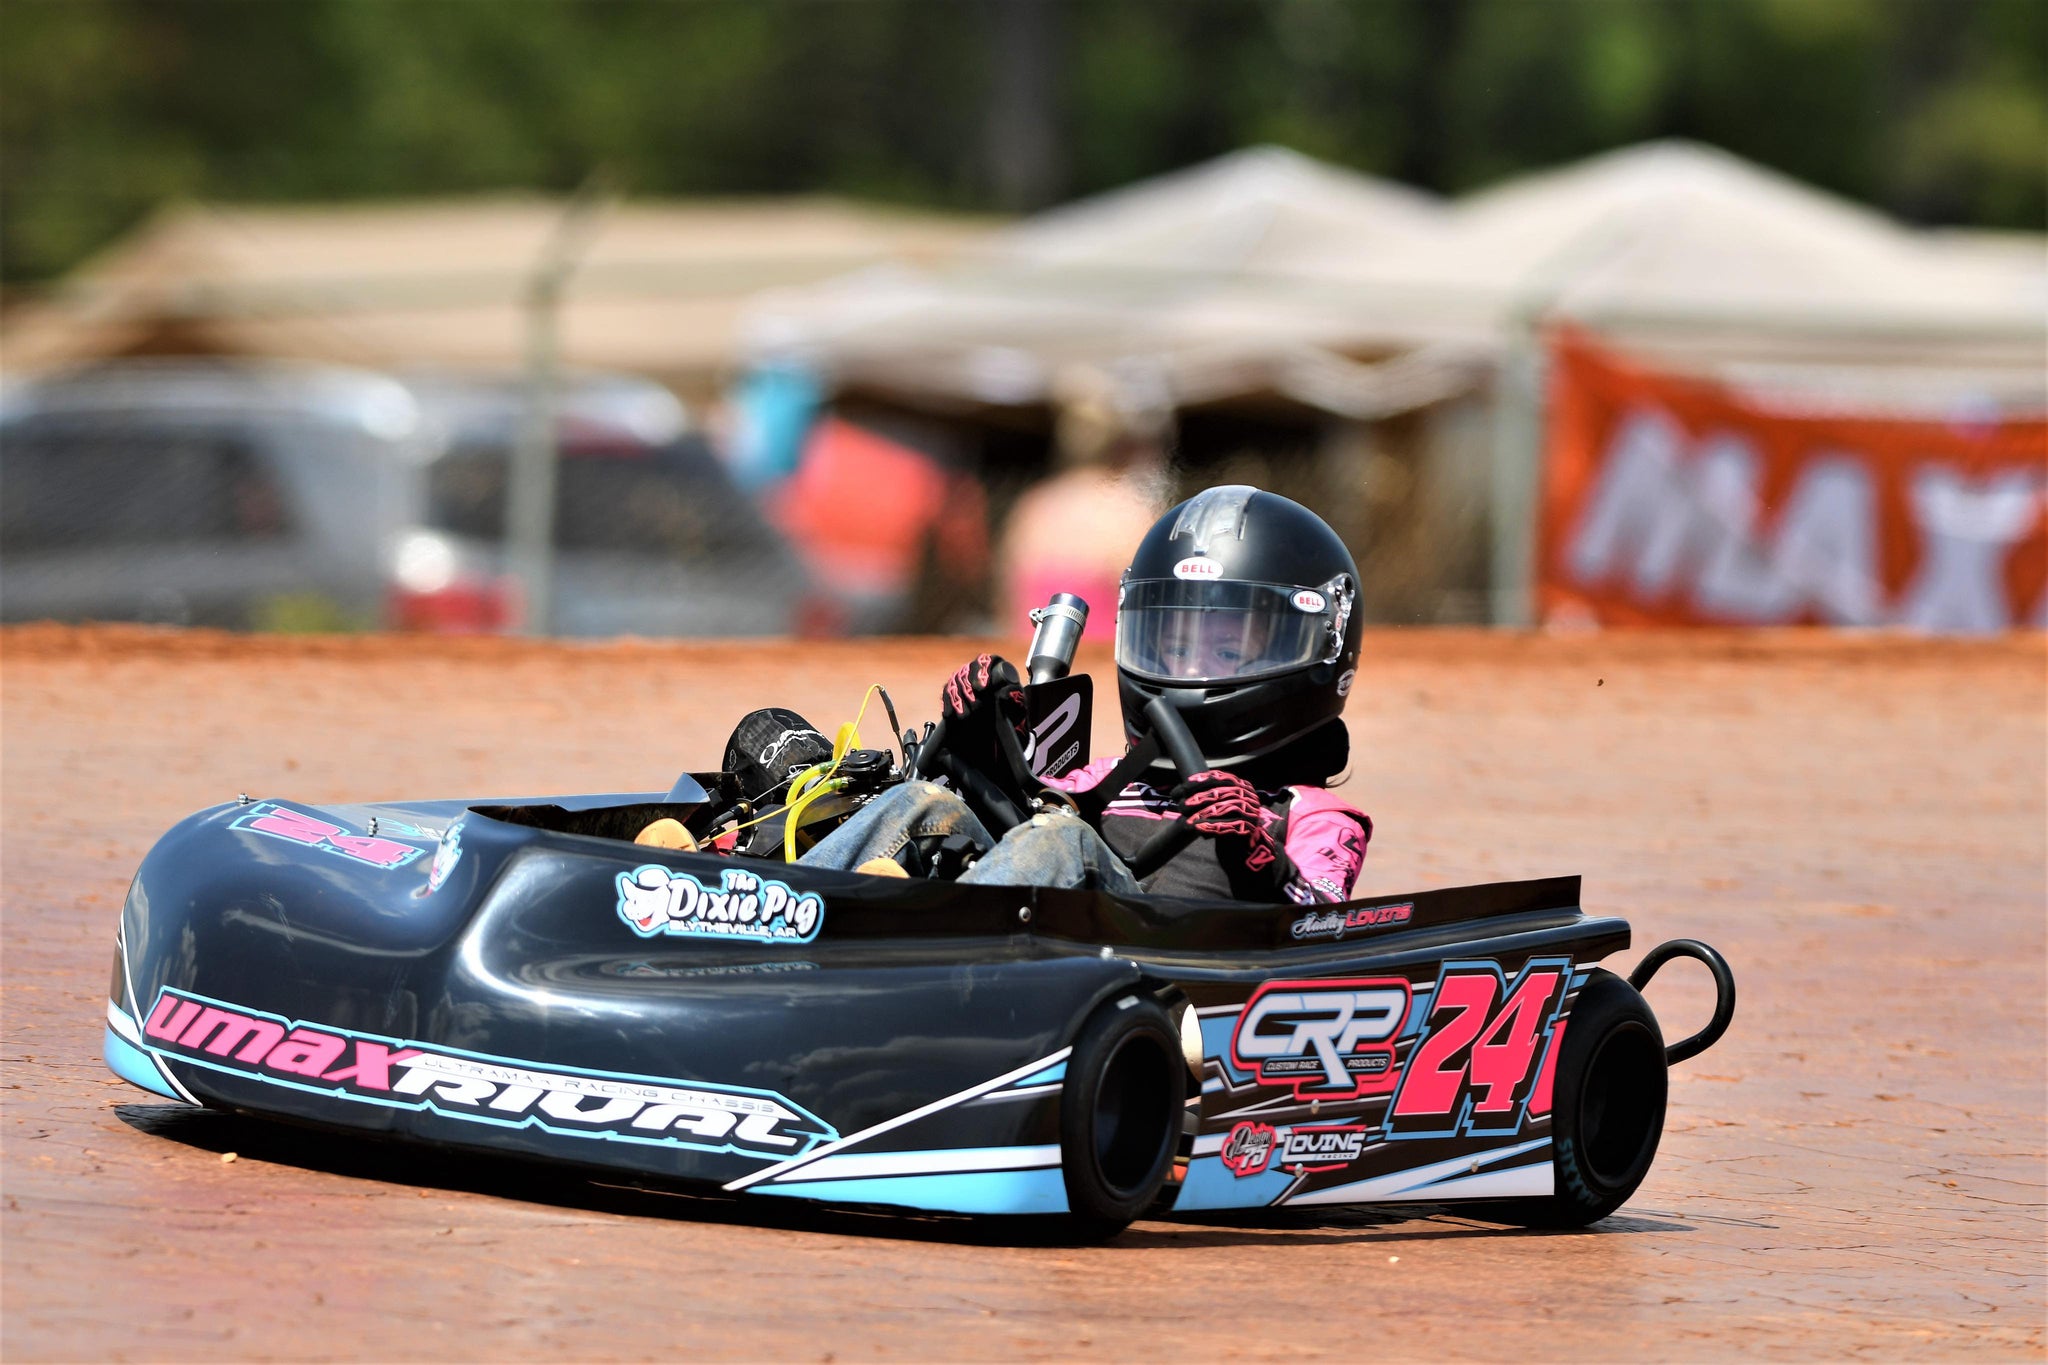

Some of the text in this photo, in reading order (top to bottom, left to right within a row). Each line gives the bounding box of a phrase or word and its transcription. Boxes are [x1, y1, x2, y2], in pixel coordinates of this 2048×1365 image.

[1566, 408, 2048, 632] MAX
[1181, 563, 1214, 574] BELL
[1299, 595, 1321, 607] BELL
[727, 872, 757, 891] The
[667, 878, 817, 935] Dixie Pig
[1235, 990, 1407, 1087] CRP
[1394, 972, 1559, 1117] 24
[1265, 1058, 1388, 1071] CUSTOM RACE PRODUCTS
[564, 1079, 659, 1099] RACING
[392, 1066, 798, 1148] RIVAL
[1280, 1133, 1367, 1163] LOVINS
